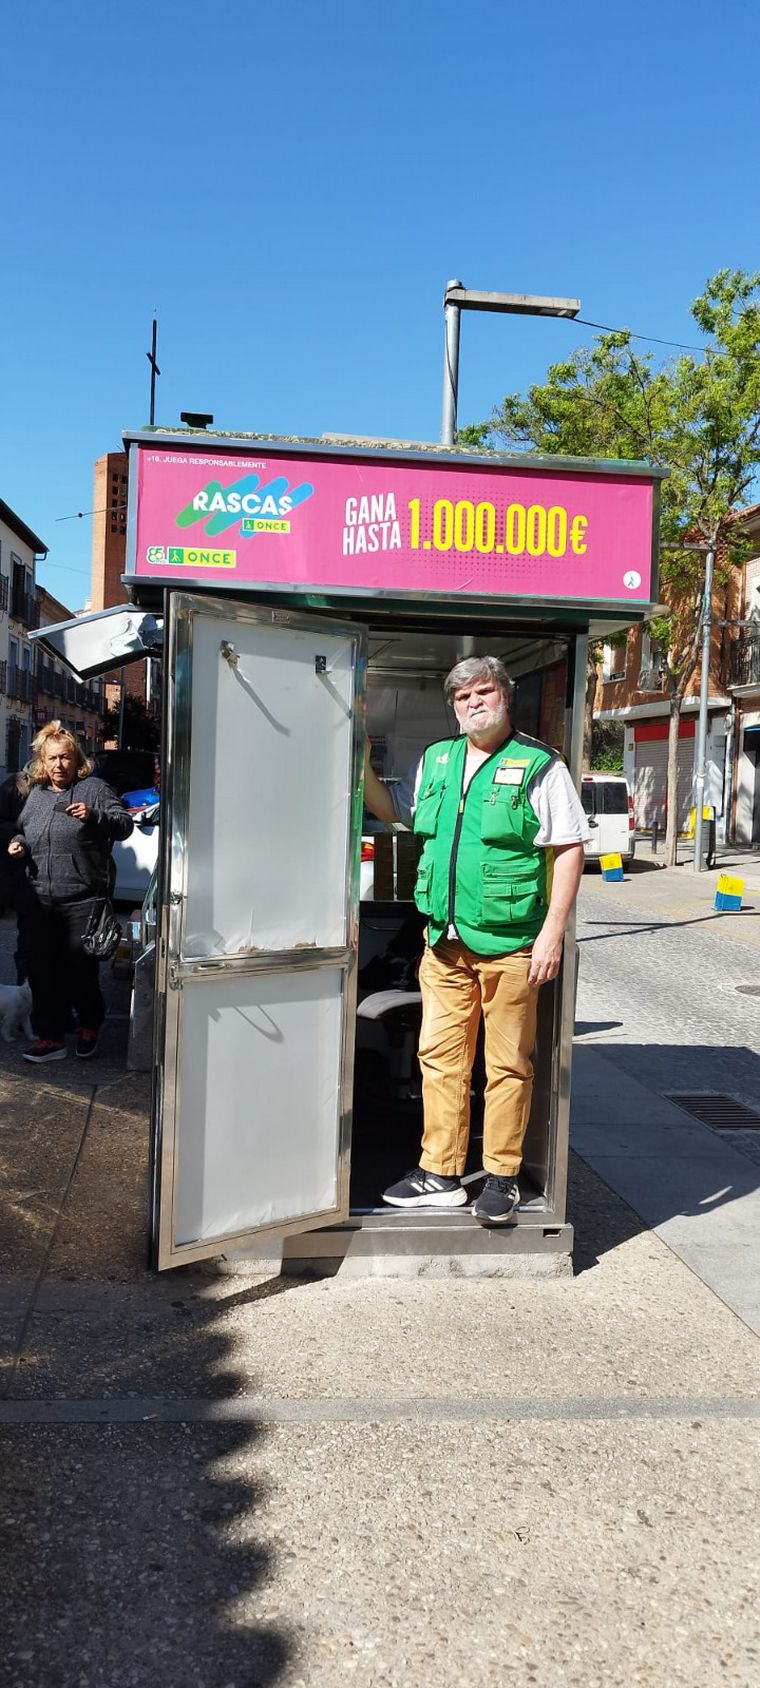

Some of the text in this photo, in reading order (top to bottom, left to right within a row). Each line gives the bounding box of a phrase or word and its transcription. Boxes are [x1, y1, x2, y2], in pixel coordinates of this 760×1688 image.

[189, 458, 267, 469] RESPONSABLEMENTE
[192, 491, 293, 516] RASCAS
[345, 492, 397, 525] GANA
[256, 521, 287, 531] ONCE
[343, 521, 402, 555] HASTA
[187, 552, 232, 564] ONCE
